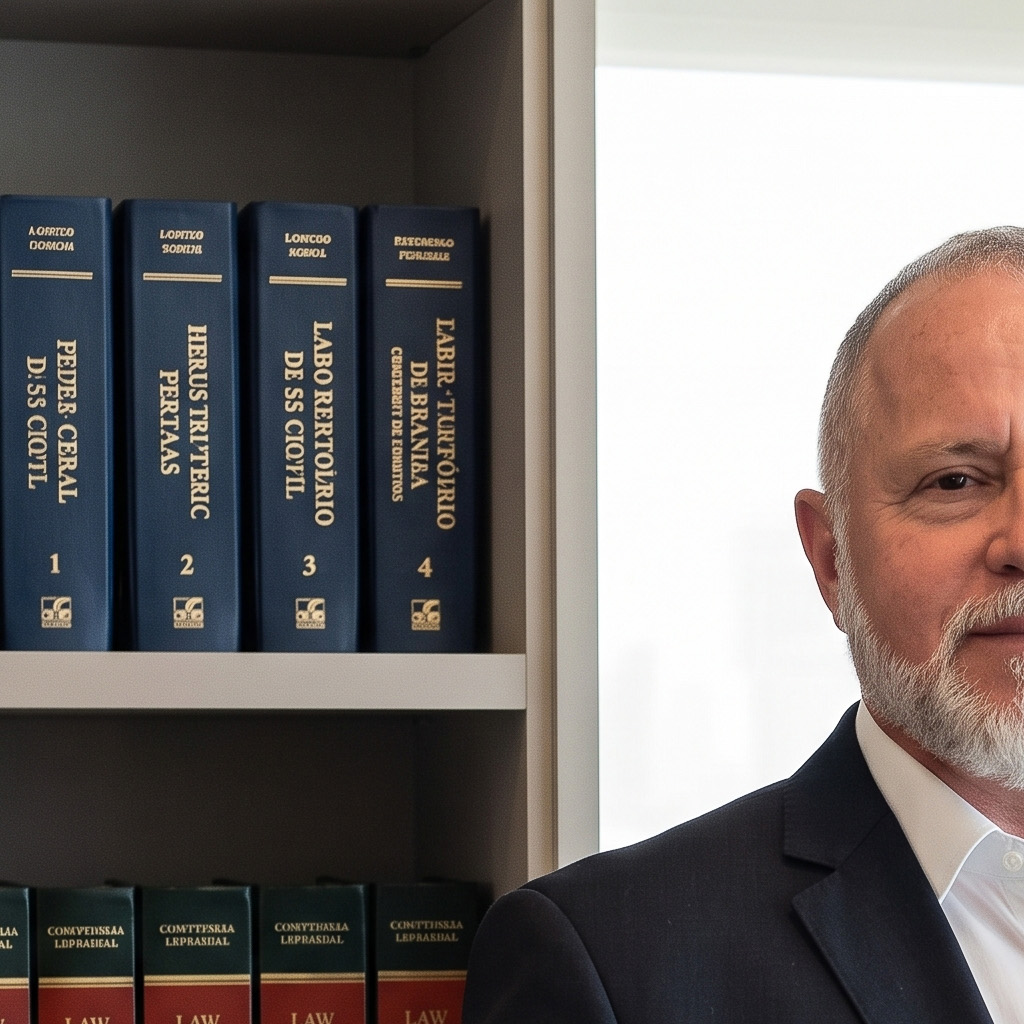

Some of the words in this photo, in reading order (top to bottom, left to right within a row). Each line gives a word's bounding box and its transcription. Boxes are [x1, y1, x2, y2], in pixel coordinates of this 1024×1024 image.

[187, 324, 208, 401] HERUS
[284, 350, 304, 381] DE
[313, 320, 334, 386] LABO
[410, 360, 429, 388] DE
[284, 386, 304, 413] SS
[159, 368, 180, 475] PERTAAS
[57, 423, 78, 504] CERAL
[49, 553, 61, 574] 1
[180, 555, 195, 576] 2
[303, 555, 317, 577] 3
[417, 557, 433, 578] 4
